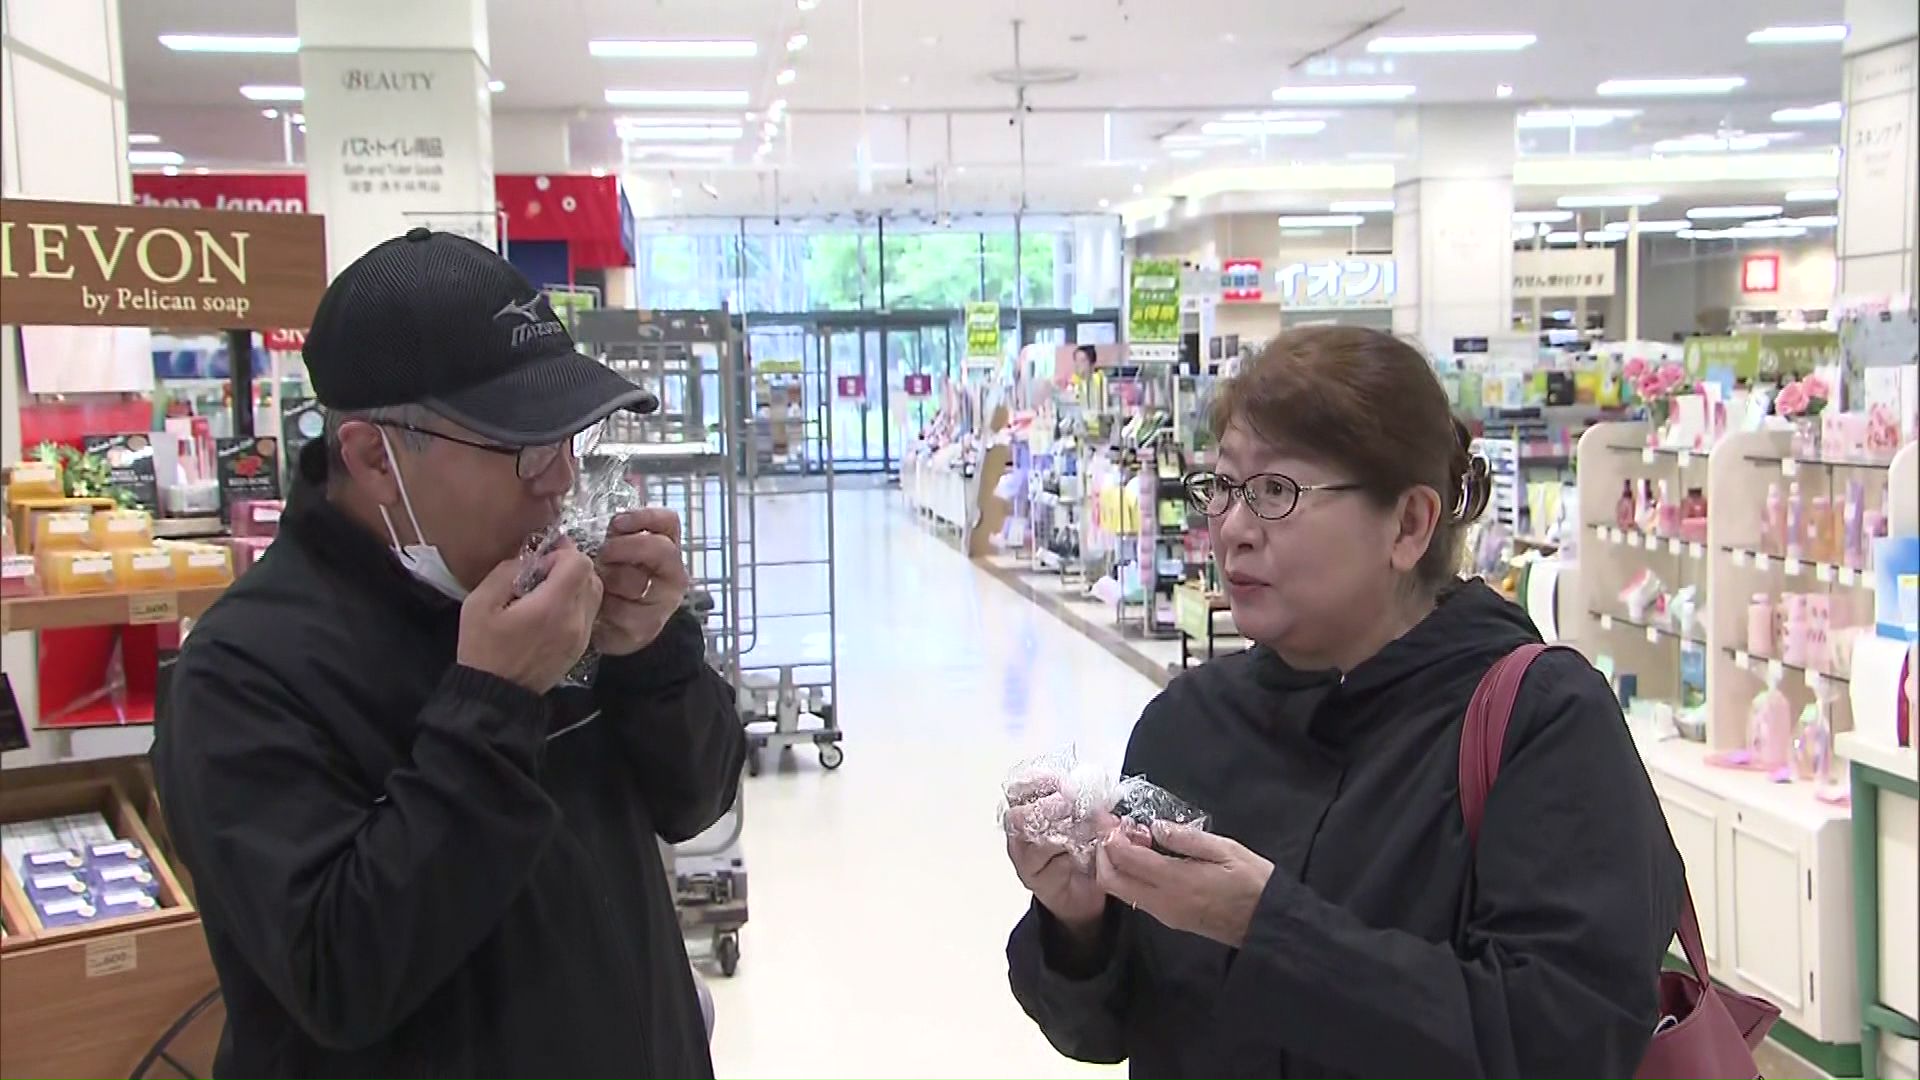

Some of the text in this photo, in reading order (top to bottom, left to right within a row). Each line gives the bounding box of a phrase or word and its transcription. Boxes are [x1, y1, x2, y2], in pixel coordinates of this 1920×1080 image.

[341, 69, 434, 90] BEAUTY
[1275, 260, 1397, 299] イオン
[82, 286, 249, 318] by Pelican soap
